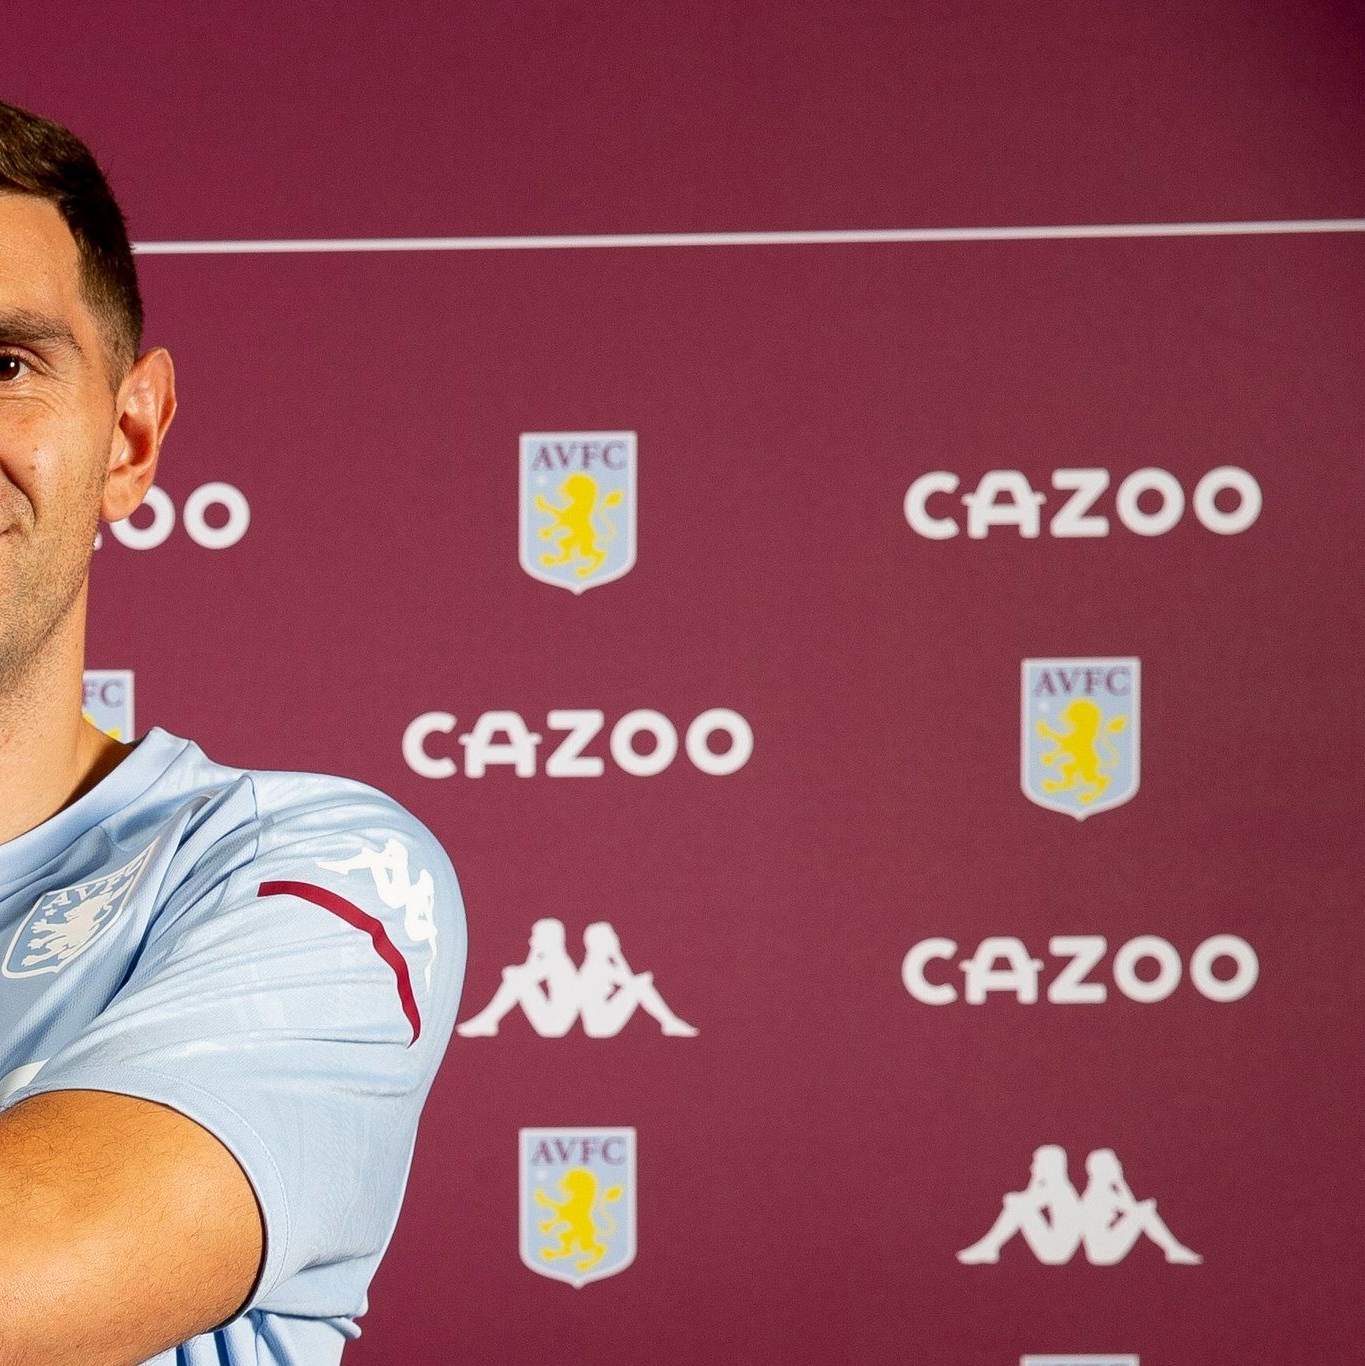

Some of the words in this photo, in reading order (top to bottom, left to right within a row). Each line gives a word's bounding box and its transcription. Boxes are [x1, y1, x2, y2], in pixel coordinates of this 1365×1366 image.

[531, 441, 627, 471] AVFC
[903, 465, 1263, 540] CAZOO
[1036, 667, 1131, 697] AVFC
[401, 707, 754, 779] CAZOO
[901, 934, 1260, 1006] CAZOO
[533, 1137, 628, 1166] AVFC
